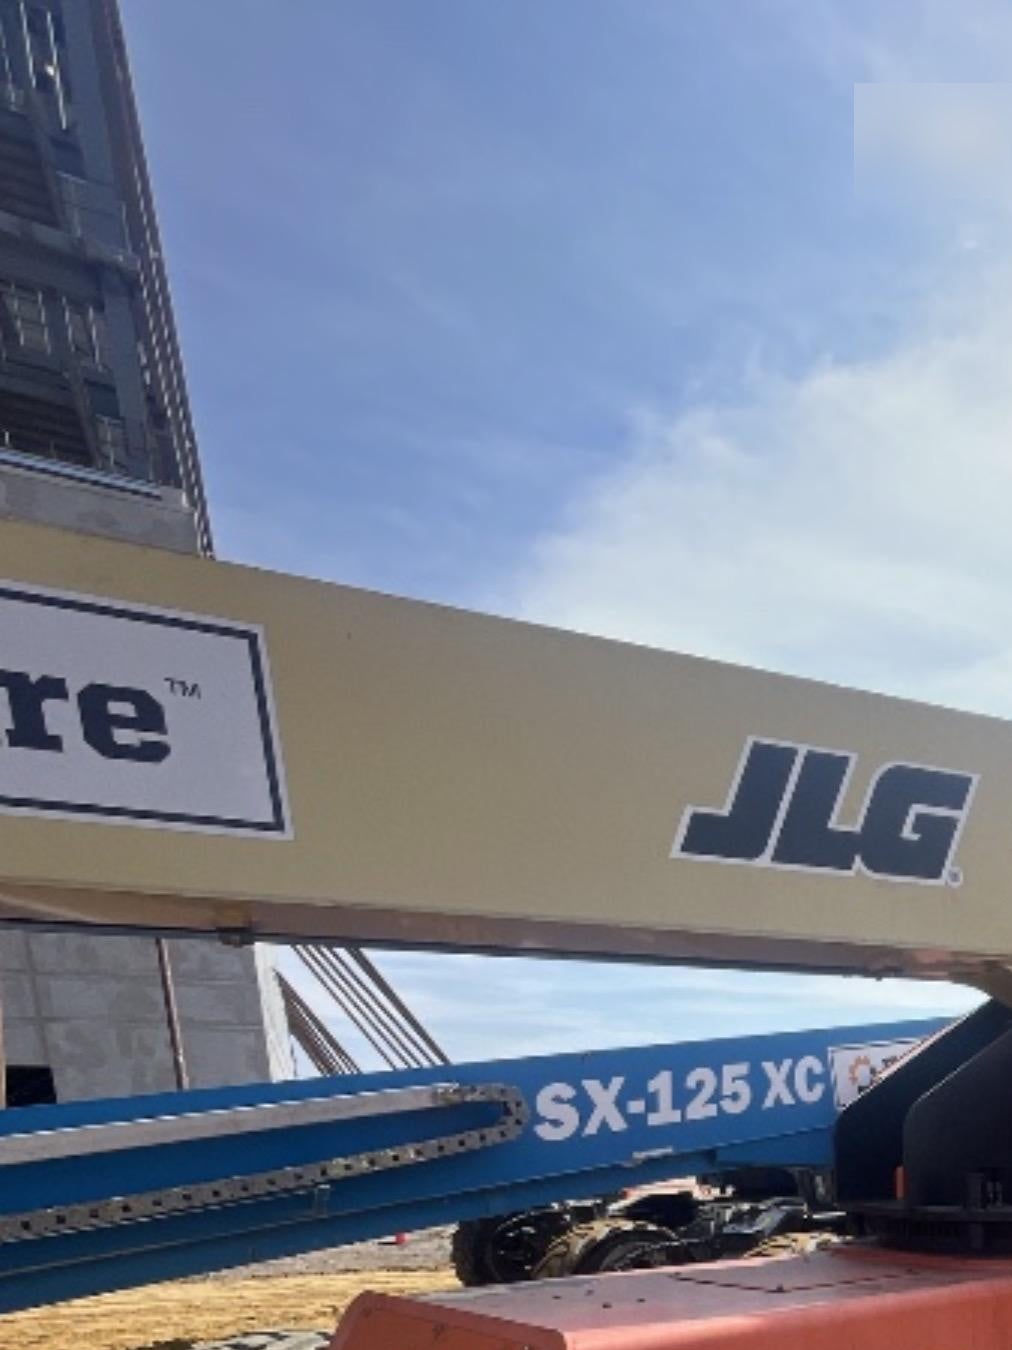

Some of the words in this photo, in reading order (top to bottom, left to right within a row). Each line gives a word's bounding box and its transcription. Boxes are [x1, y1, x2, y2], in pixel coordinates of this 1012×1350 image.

[670, 736, 979, 884] JLG
[533, 1062, 751, 1141] SX-125
[762, 1056, 826, 1109] XC
